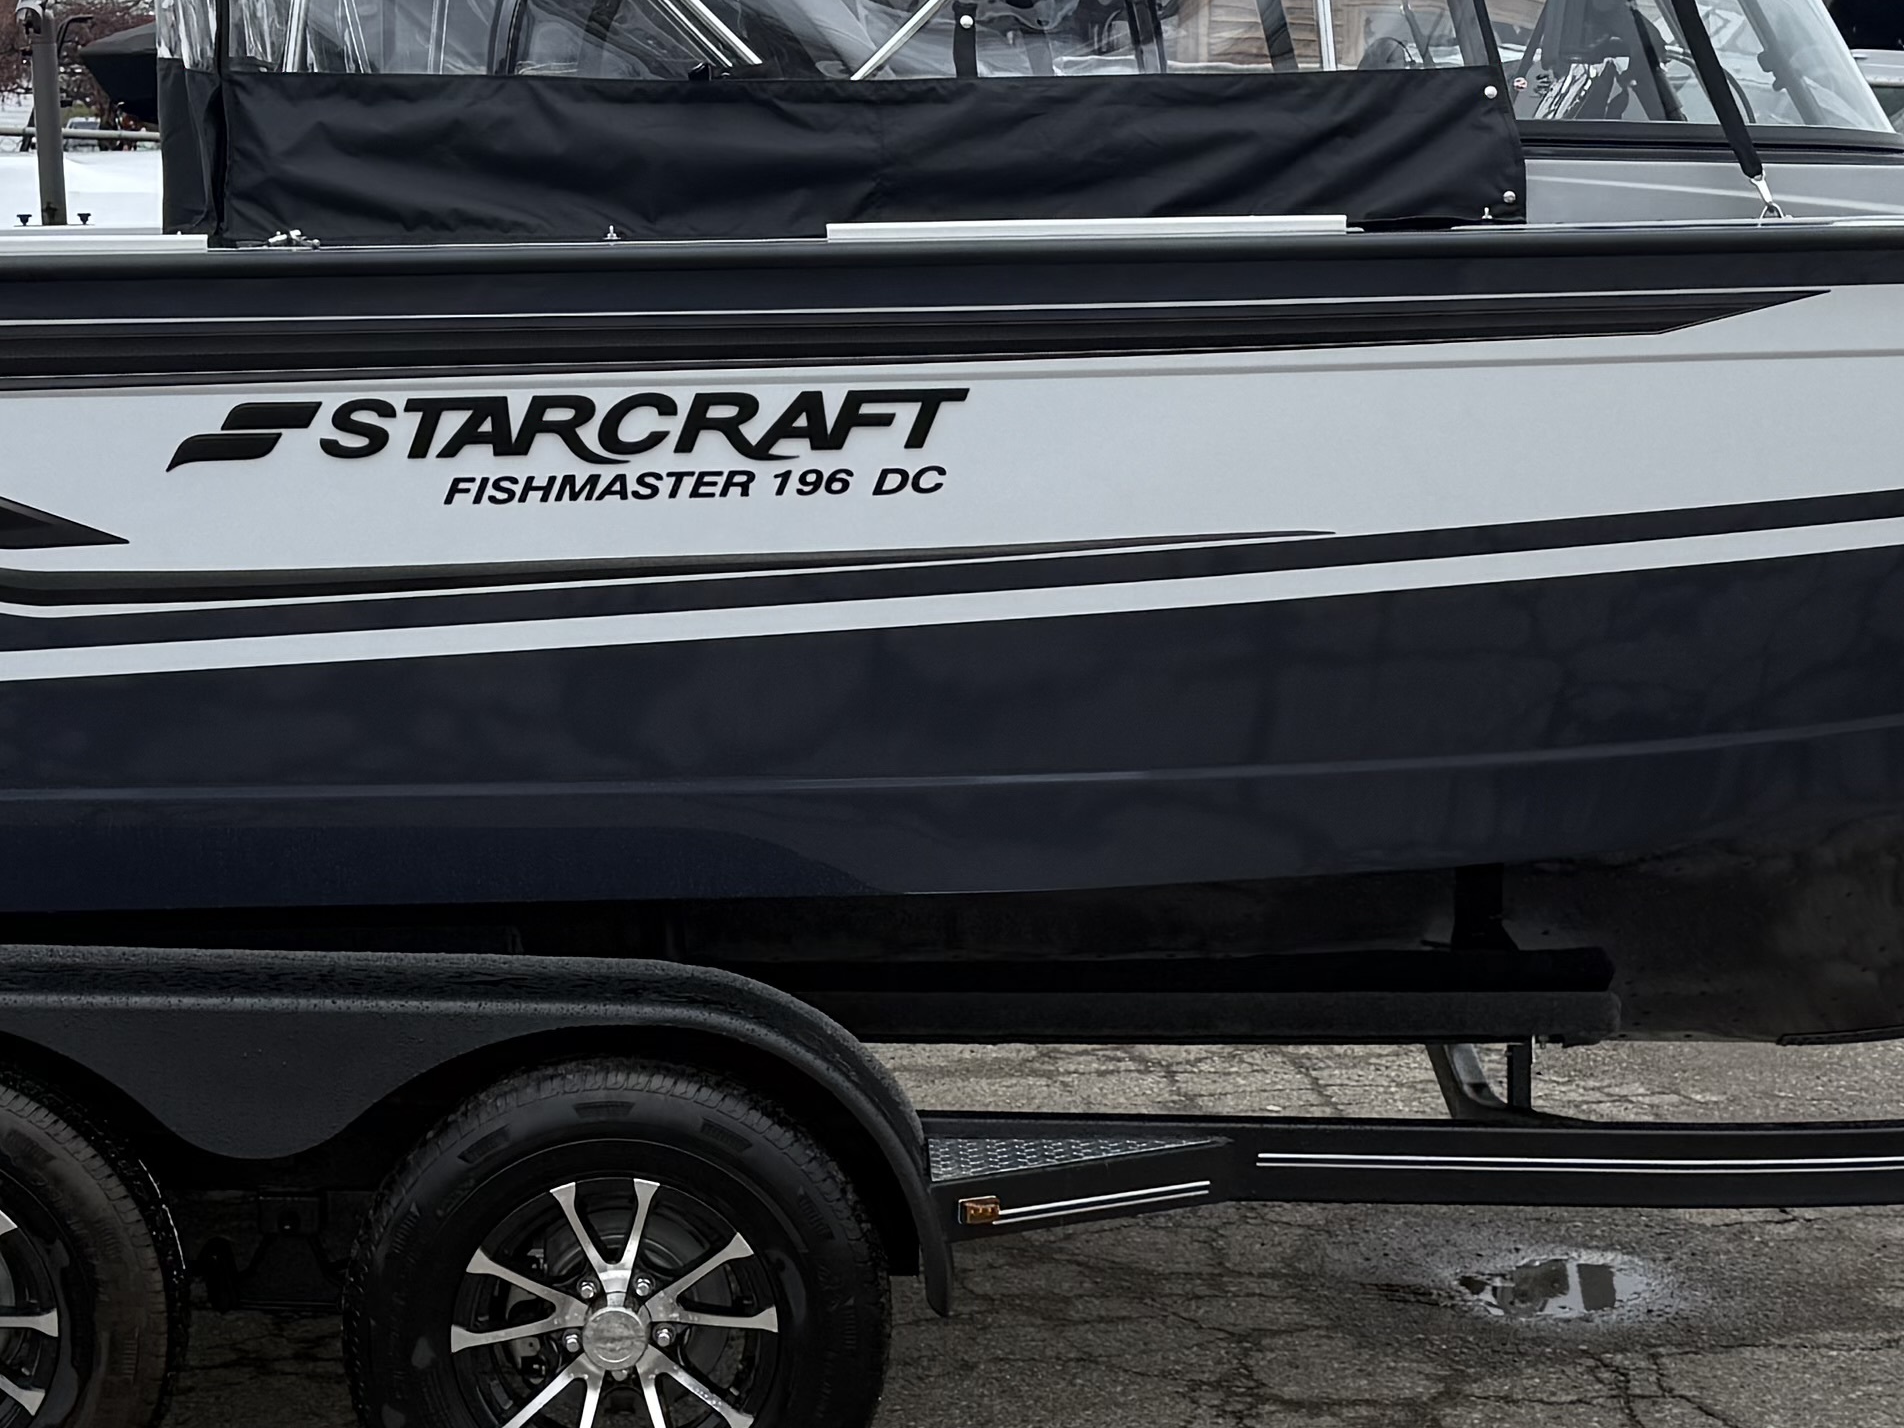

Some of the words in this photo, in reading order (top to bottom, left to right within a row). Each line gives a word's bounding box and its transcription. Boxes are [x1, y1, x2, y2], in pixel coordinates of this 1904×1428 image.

[319, 387, 971, 465] STARCRAFT
[443, 469, 757, 505] FISHMASTER
[772, 468, 854, 497] 196
[871, 465, 947, 496] DC
